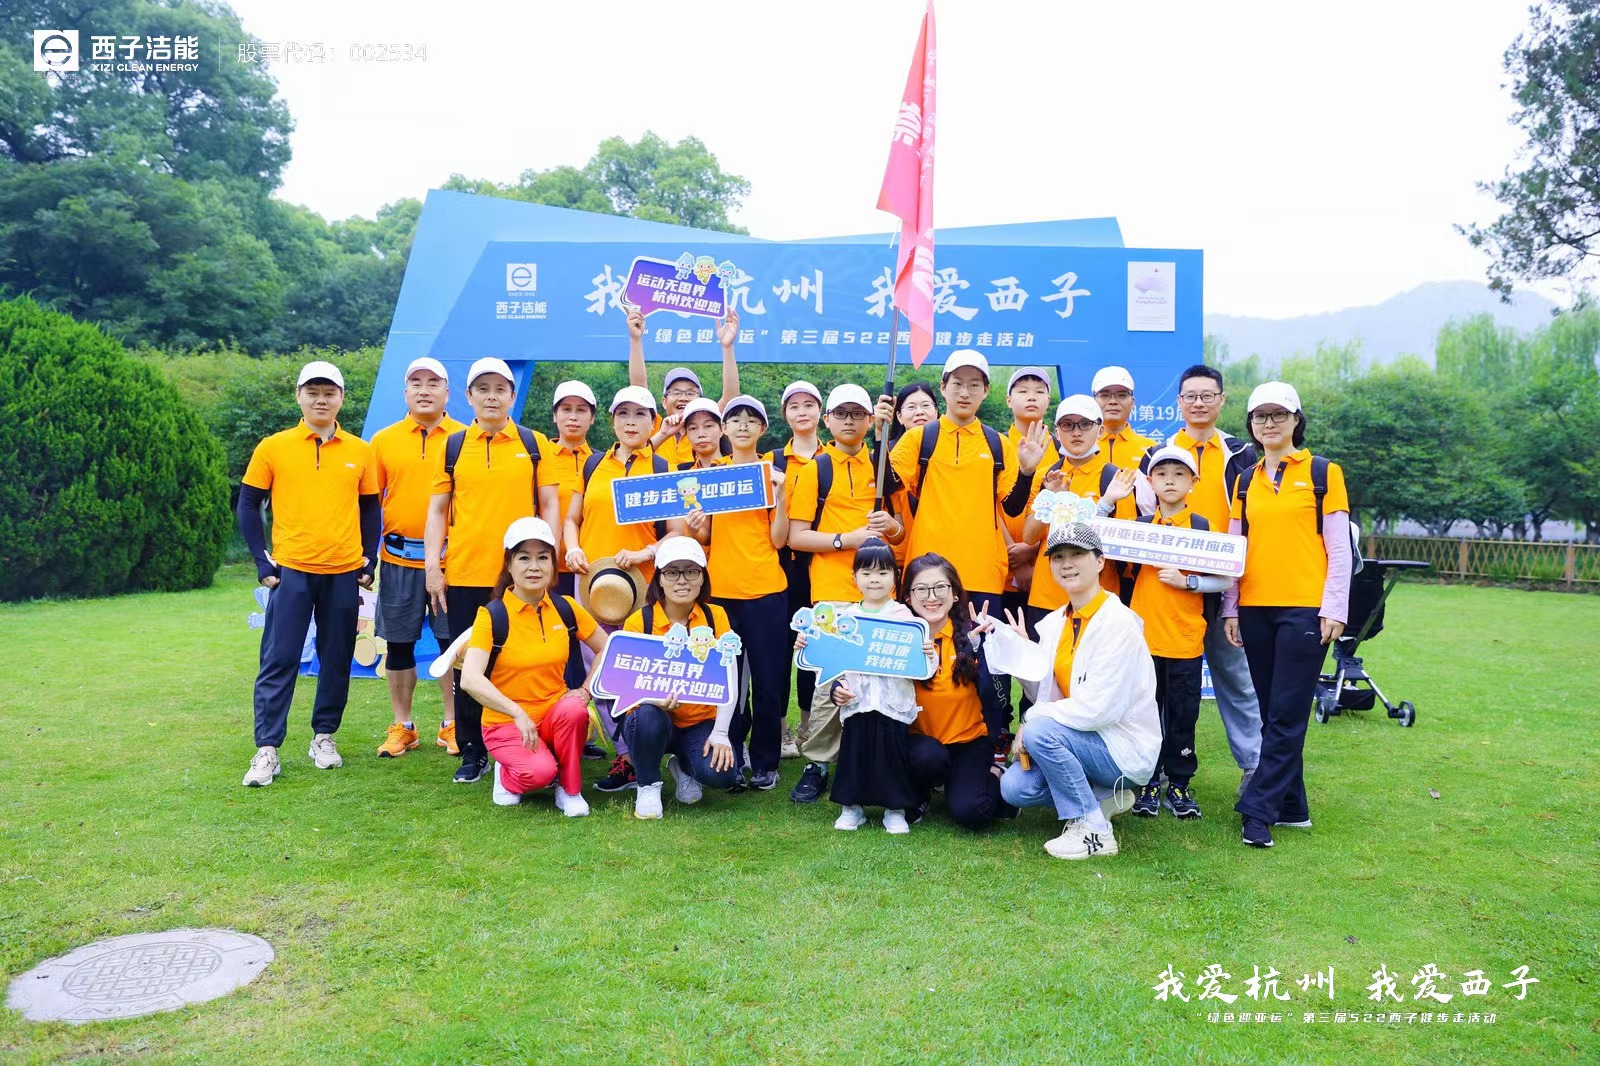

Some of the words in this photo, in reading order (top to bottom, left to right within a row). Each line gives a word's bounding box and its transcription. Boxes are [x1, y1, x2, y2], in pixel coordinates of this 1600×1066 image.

[637, 273, 707, 298] 运动无国界
[496, 301, 547, 314] 西子洁能
[652, 290, 722, 314] 杭州欢迎您
[625, 487, 678, 508] 健步走
[701, 480, 754, 499] 迎亚运
[872, 628, 914, 643] 我运动
[868, 641, 912, 657] 我健康
[613, 653, 705, 679] 运动无国界
[864, 655, 908, 671] 我快乐
[634, 673, 725, 699] 杭州欢迎您
